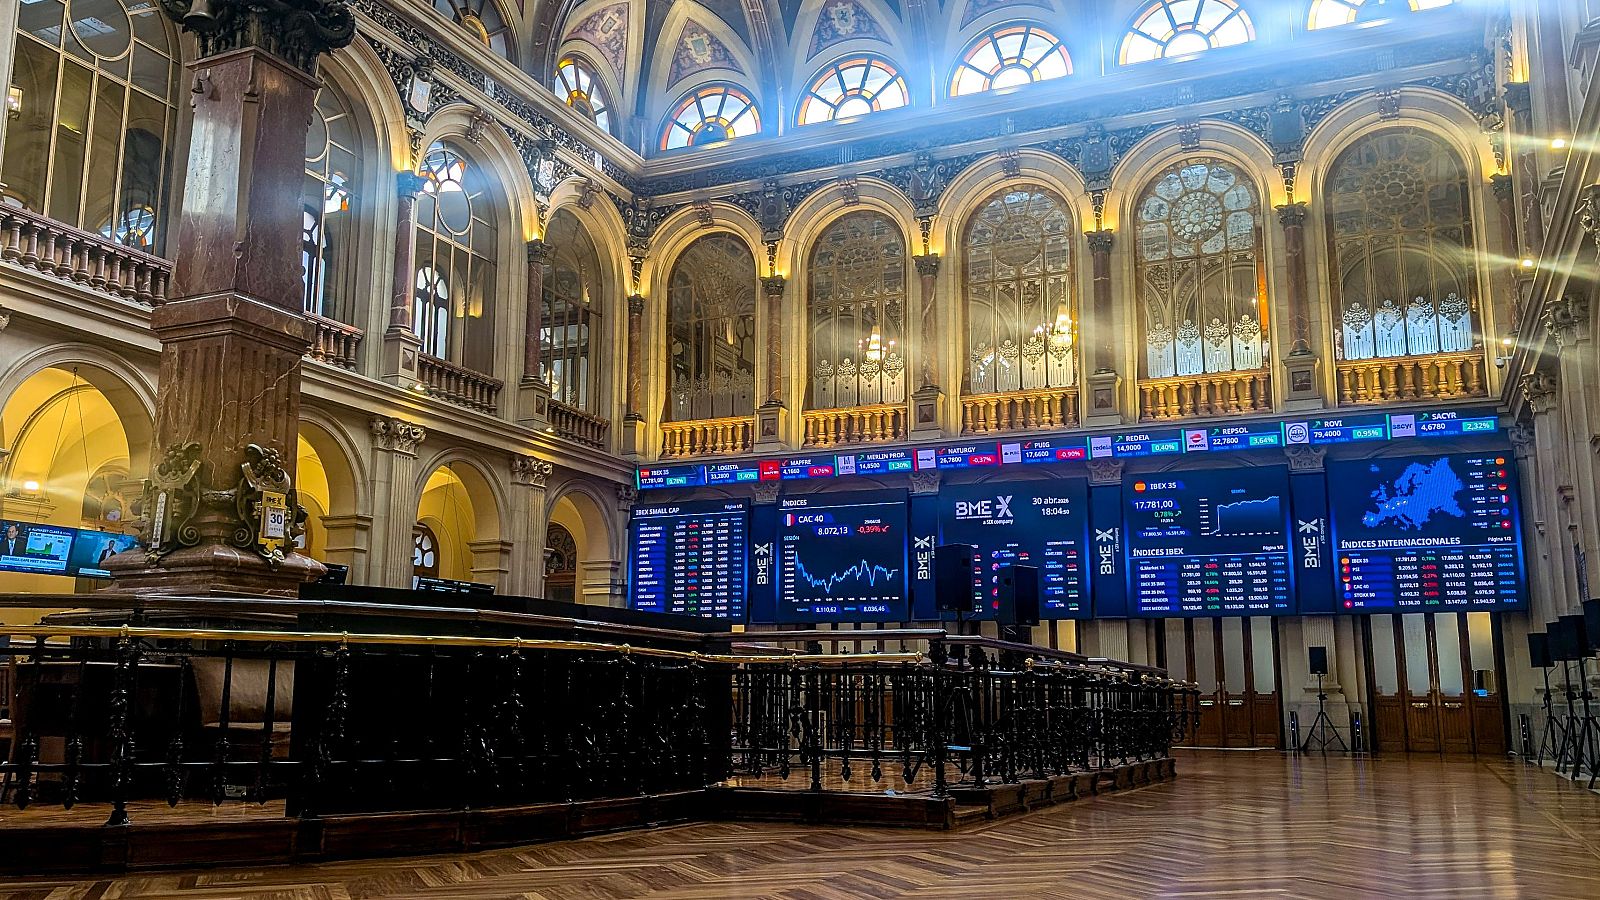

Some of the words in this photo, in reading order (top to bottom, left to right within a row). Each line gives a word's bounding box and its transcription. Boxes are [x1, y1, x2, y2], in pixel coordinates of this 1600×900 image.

[956, 500, 992, 516] BME
[1135, 500, 1173, 509] 17.781,00
[270, 514, 282, 524] 30
[818, 526, 848, 535] 8.072,13
[1342, 540, 1376, 548] ÍNDICES
[1378, 537, 1460, 547] INTERNACIONALES
[1133, 548, 1164, 556] ÍNDICES
[1303, 537, 1318, 568] BME
[918, 552, 928, 579] BME
[1100, 545, 1112, 574] BME
[757, 558, 766, 584] BME
